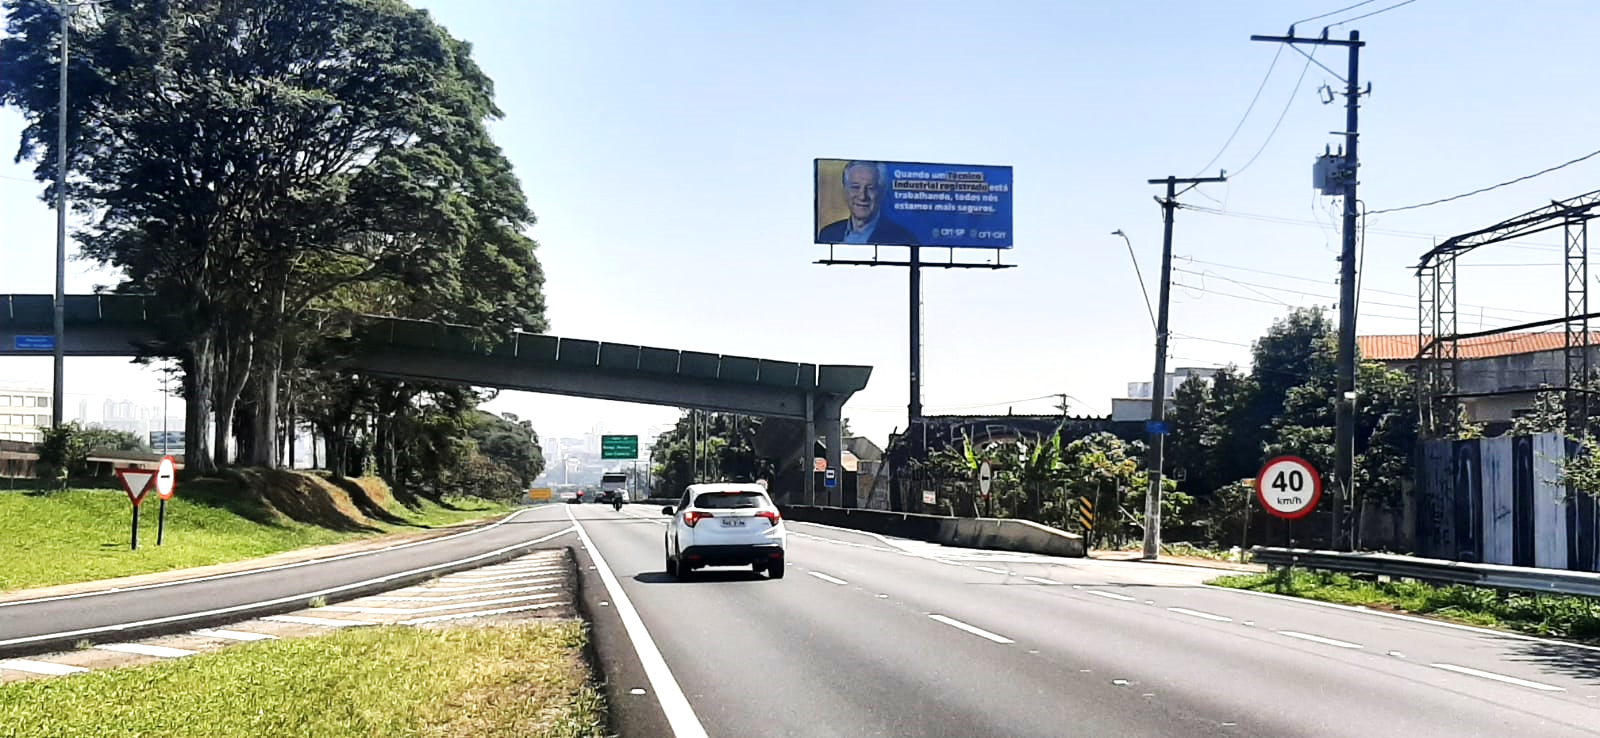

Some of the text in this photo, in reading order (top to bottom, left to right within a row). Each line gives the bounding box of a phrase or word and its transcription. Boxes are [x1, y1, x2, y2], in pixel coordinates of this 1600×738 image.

[894, 170, 929, 179] Quando
[894, 180, 1009, 192] Industrial registrado está
[894, 192, 998, 202] trabalhando, todos nós
[934, 203, 956, 211] mais
[957, 205, 996, 213] seguros.
[1271, 470, 1304, 492] 40
[1277, 496, 1302, 505] km/h
